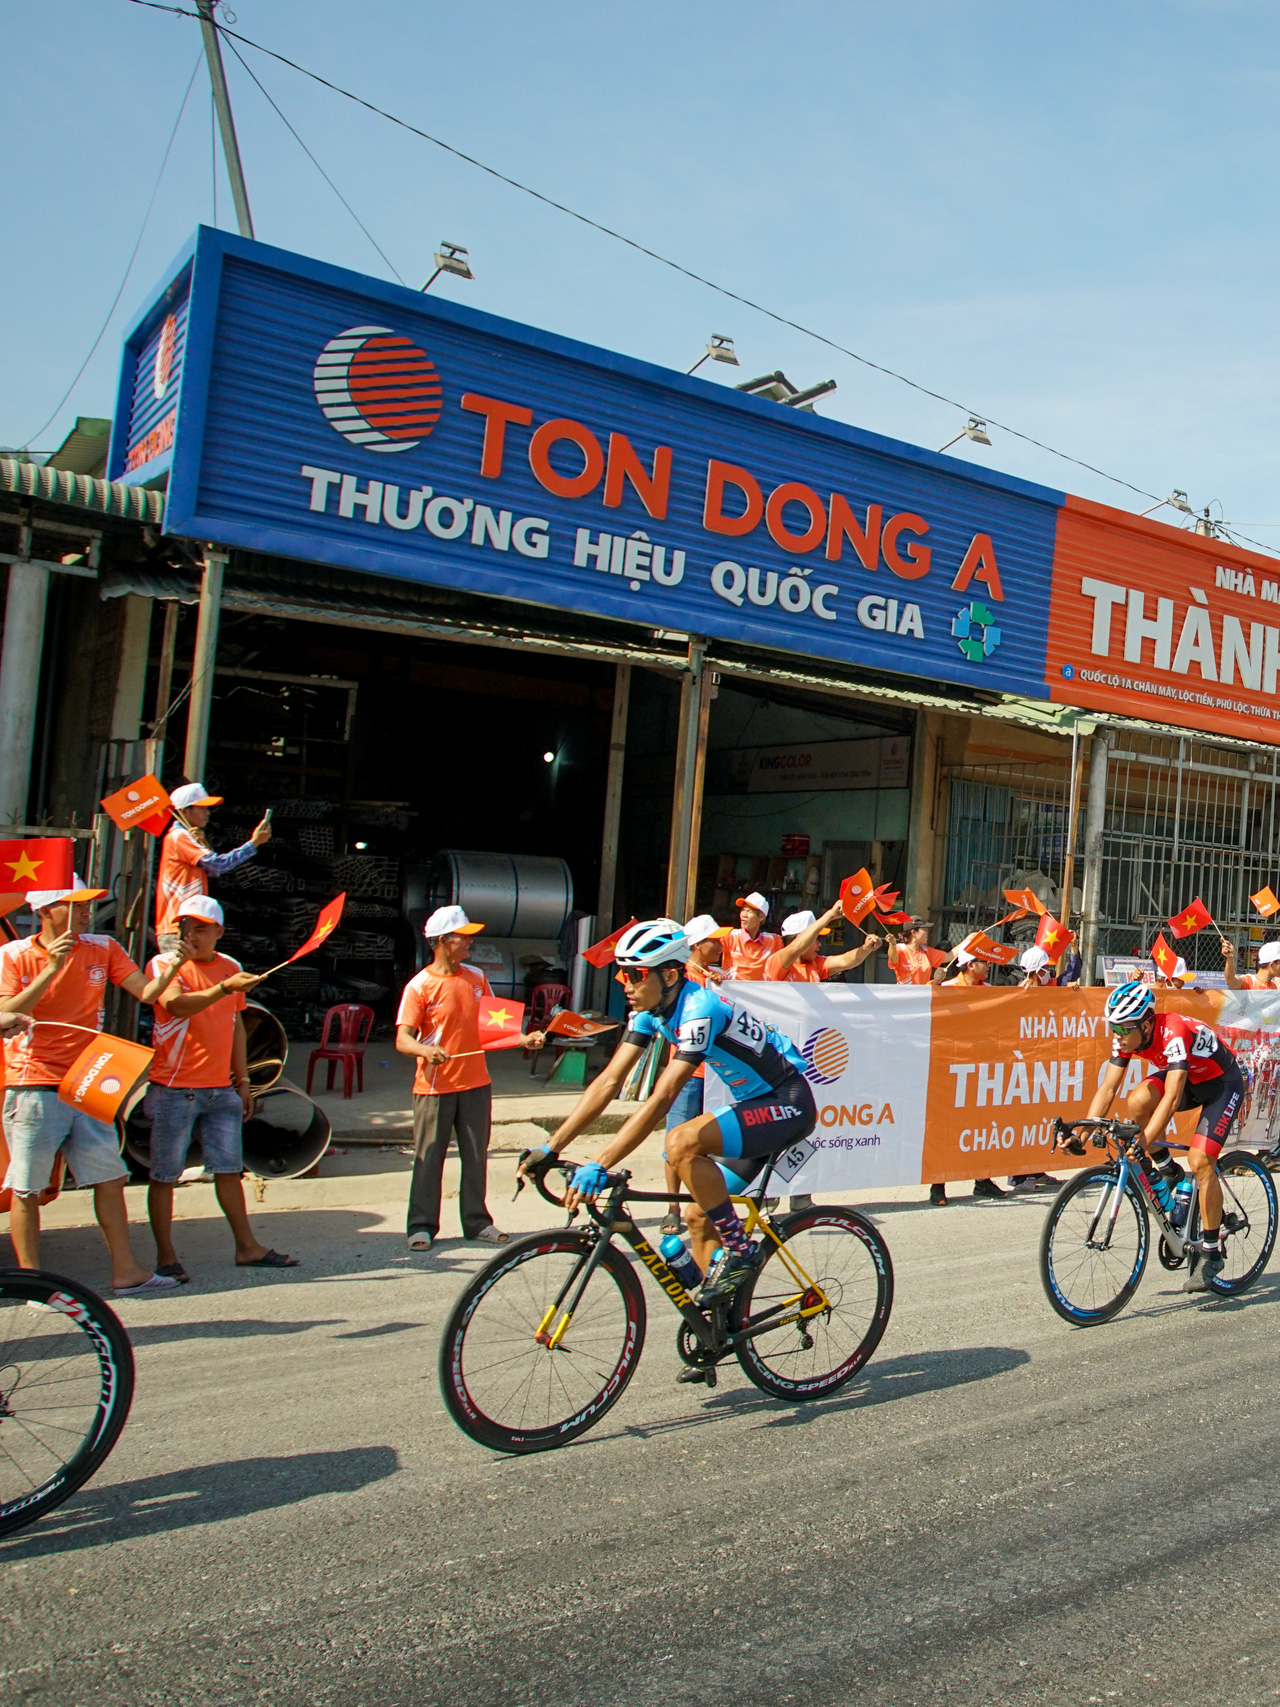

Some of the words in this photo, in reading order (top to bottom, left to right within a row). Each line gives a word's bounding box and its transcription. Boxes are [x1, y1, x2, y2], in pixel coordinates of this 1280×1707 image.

[460, 392, 673, 520] TON
[702, 459, 932, 580] DONG
[950, 532, 1005, 601] A
[301, 465, 550, 559] THƯƠNG
[573, 530, 686, 591] HIỆU
[710, 561, 839, 621] QUỐC
[857, 595, 925, 640] GIA
[1215, 565, 1257, 599] NHÀ
[1080, 669, 1106, 684] QUỐC
[1107, 673, 1120, 689] LỘ
[1121, 678, 1132, 690] 1A
[1178, 689, 1195, 704] LỘC
[1216, 698, 1232, 711] PHÚ
[120, 808, 136, 819] TON
[134, 798, 154, 812] DONG
[975, 946, 986, 955] TON
[1127, 971, 1155, 984] KBE
[563, 1023, 578, 1032] TON
[687, 1026, 705, 1045] 45
[737, 1010, 764, 1042] 45
[1020, 1010, 1058, 1039] NHÀ
[1062, 1009, 1099, 1038] MÁY
[1196, 1028, 1216, 1053] 54
[93, 1052, 114, 1069] TON
[76, 1068, 99, 1097] DONG
[949, 1050, 1084, 1108] THÀNH
[73, 1095, 83, 1103] A
[816, 1103, 874, 1127] ONG
[876, 1103, 895, 1125] A
[828, 1135, 853, 1150] sống
[855, 1134, 881, 1147] xanh
[958, 1120, 1015, 1153] CHÀO
[1021, 1117, 1066, 1147] MỪ
[785, 1146, 806, 1170] 45
[1260, 1173, 1275, 1253] FULCRUM
[813, 1217, 886, 1276] FULCRUM
[461, 1246, 539, 1326] RACING
[633, 1241, 694, 1308] FACTOR
[779, 1314, 801, 1326] FACTOR
[452, 1328, 471, 1403] SPEED
[559, 1320, 637, 1433] FULCRUM
[796, 1365, 850, 1392] SPEED
